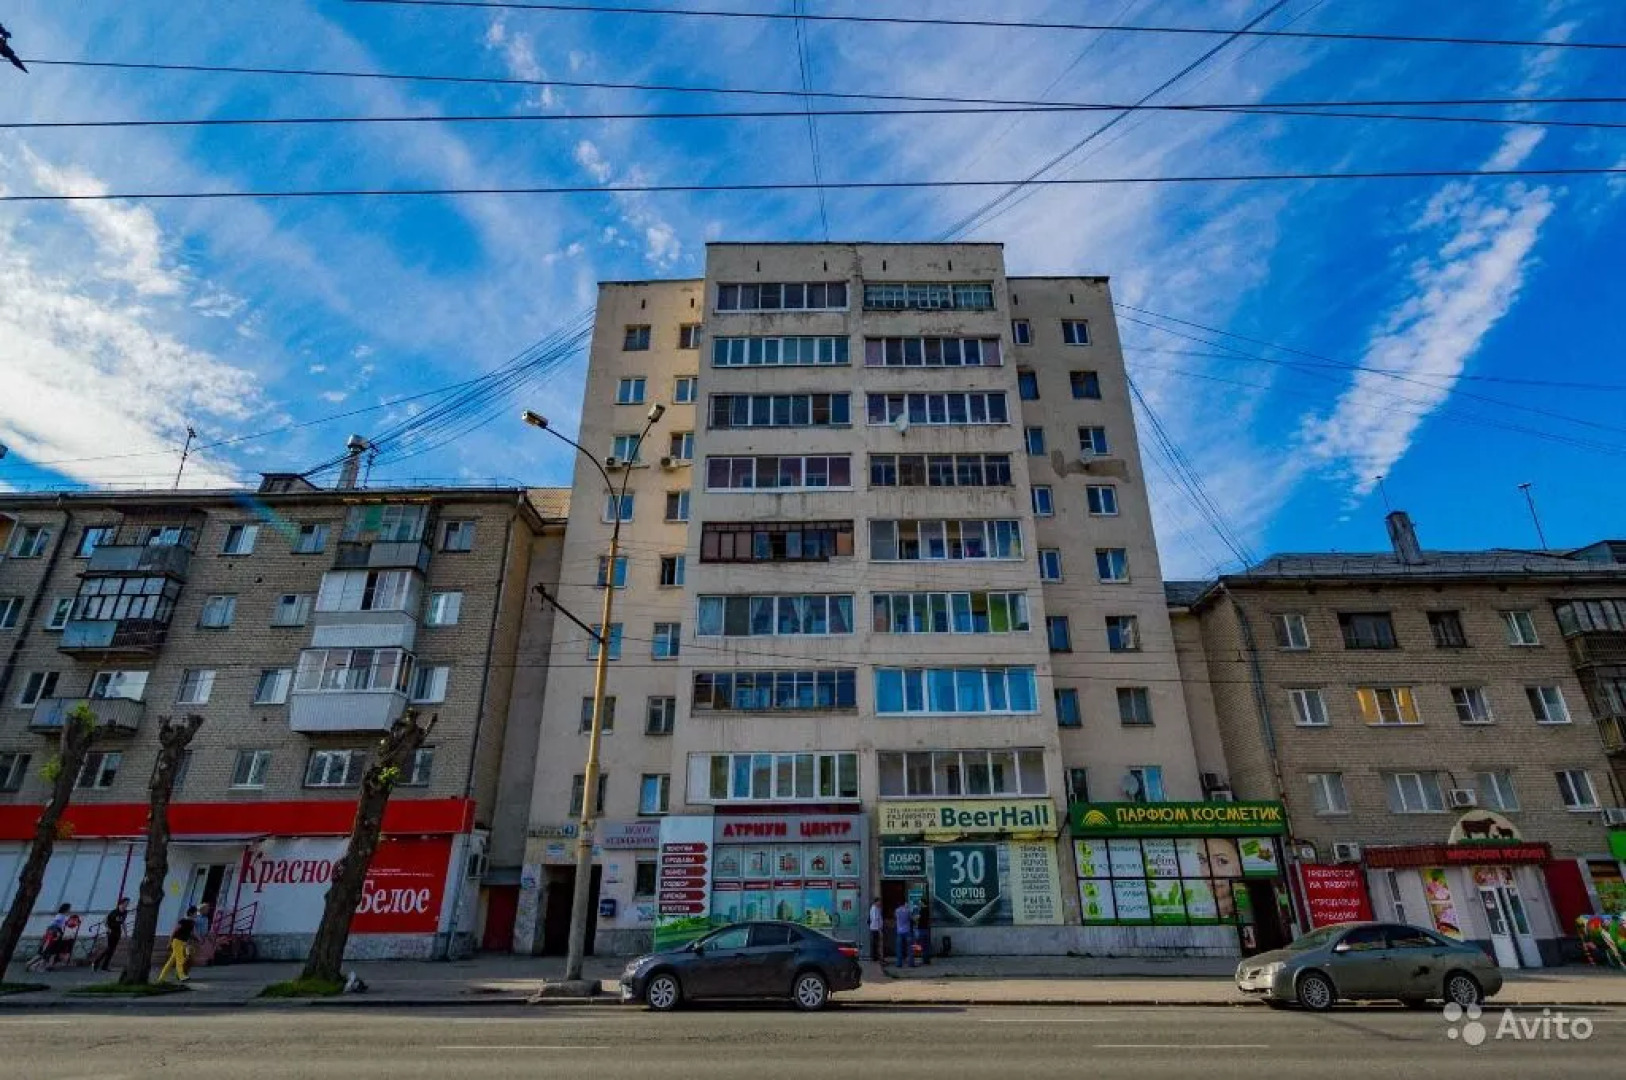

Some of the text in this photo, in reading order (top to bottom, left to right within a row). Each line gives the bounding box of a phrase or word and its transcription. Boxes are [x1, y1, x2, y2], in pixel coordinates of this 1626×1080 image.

[940, 804, 1049, 828] BeerHall
[1116, 806, 1281, 822] ПАРФЮМ КОСМЕТИК
[723, 822, 851, 838] АТРИУМ ЦЕНТР
[889, 853, 921, 864] ДОБРО
[949, 851, 986, 884] 30
[355, 879, 430, 914] Белое
[950, 887, 986, 899] СОРТОВ
